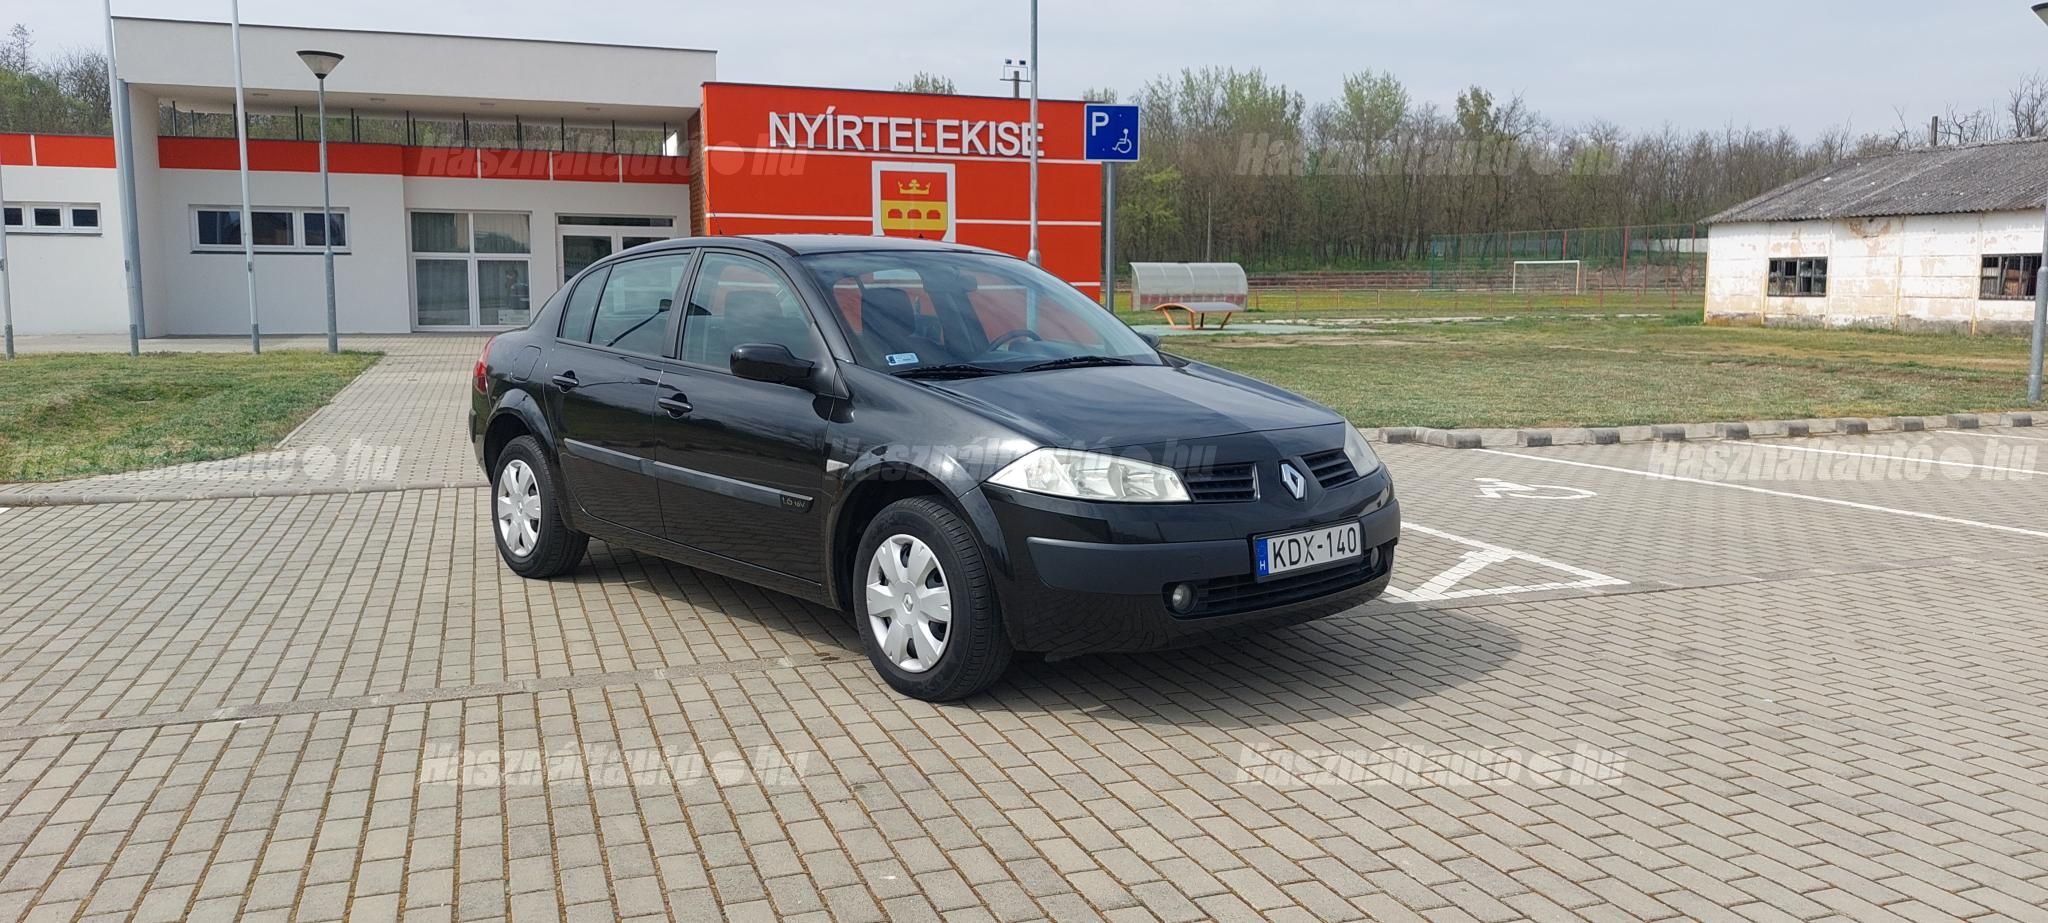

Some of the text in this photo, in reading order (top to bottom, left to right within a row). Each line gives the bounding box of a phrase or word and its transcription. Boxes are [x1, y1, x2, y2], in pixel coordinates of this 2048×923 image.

[769, 105, 1045, 157] NYÍRTELEKISE
[1092, 112, 1109, 136] P
[1273, 527, 1356, 569] KDX-140
[1260, 561, 1266, 571] H
